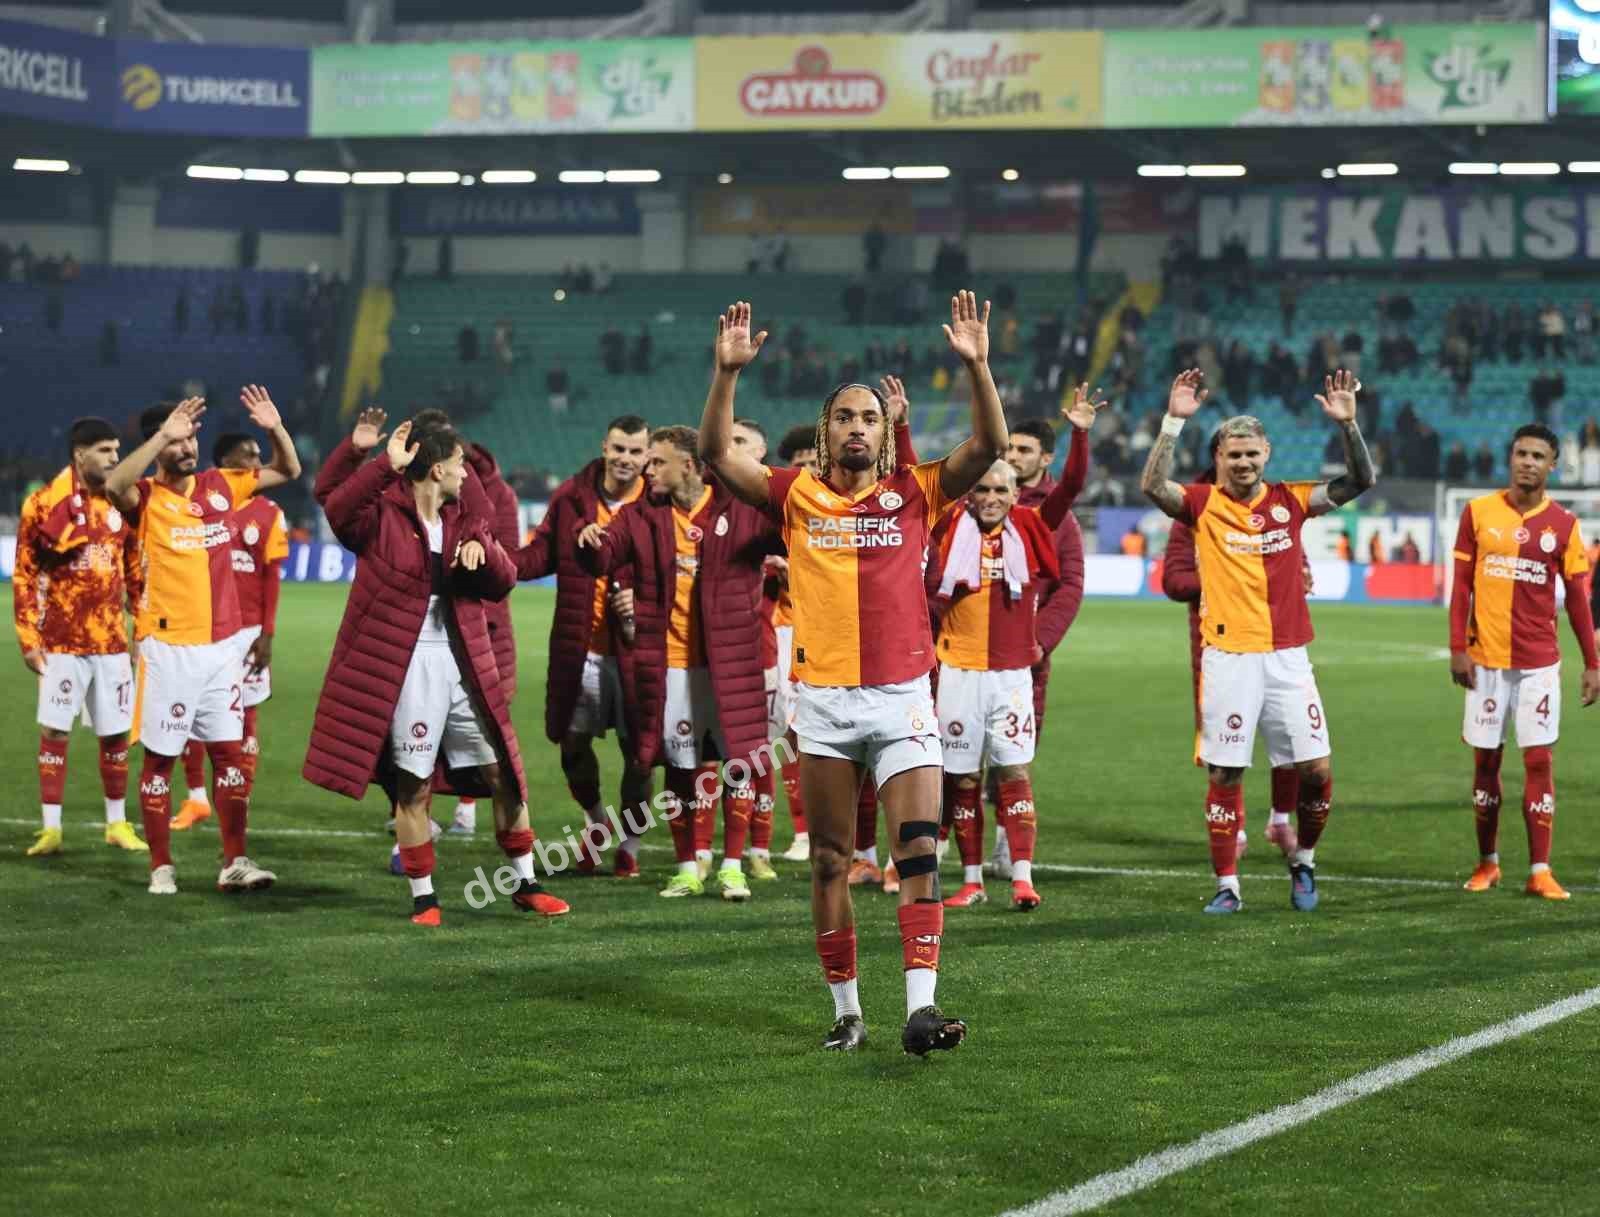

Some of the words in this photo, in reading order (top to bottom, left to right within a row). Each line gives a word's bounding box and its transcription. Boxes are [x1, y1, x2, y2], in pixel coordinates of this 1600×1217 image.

[166, 75, 300, 107] TURKCELL
[1307, 703, 1323, 730] 9
[1535, 693, 1551, 719] 4
[1004, 712, 1033, 739] 34
[940, 740, 969, 751] ydia
